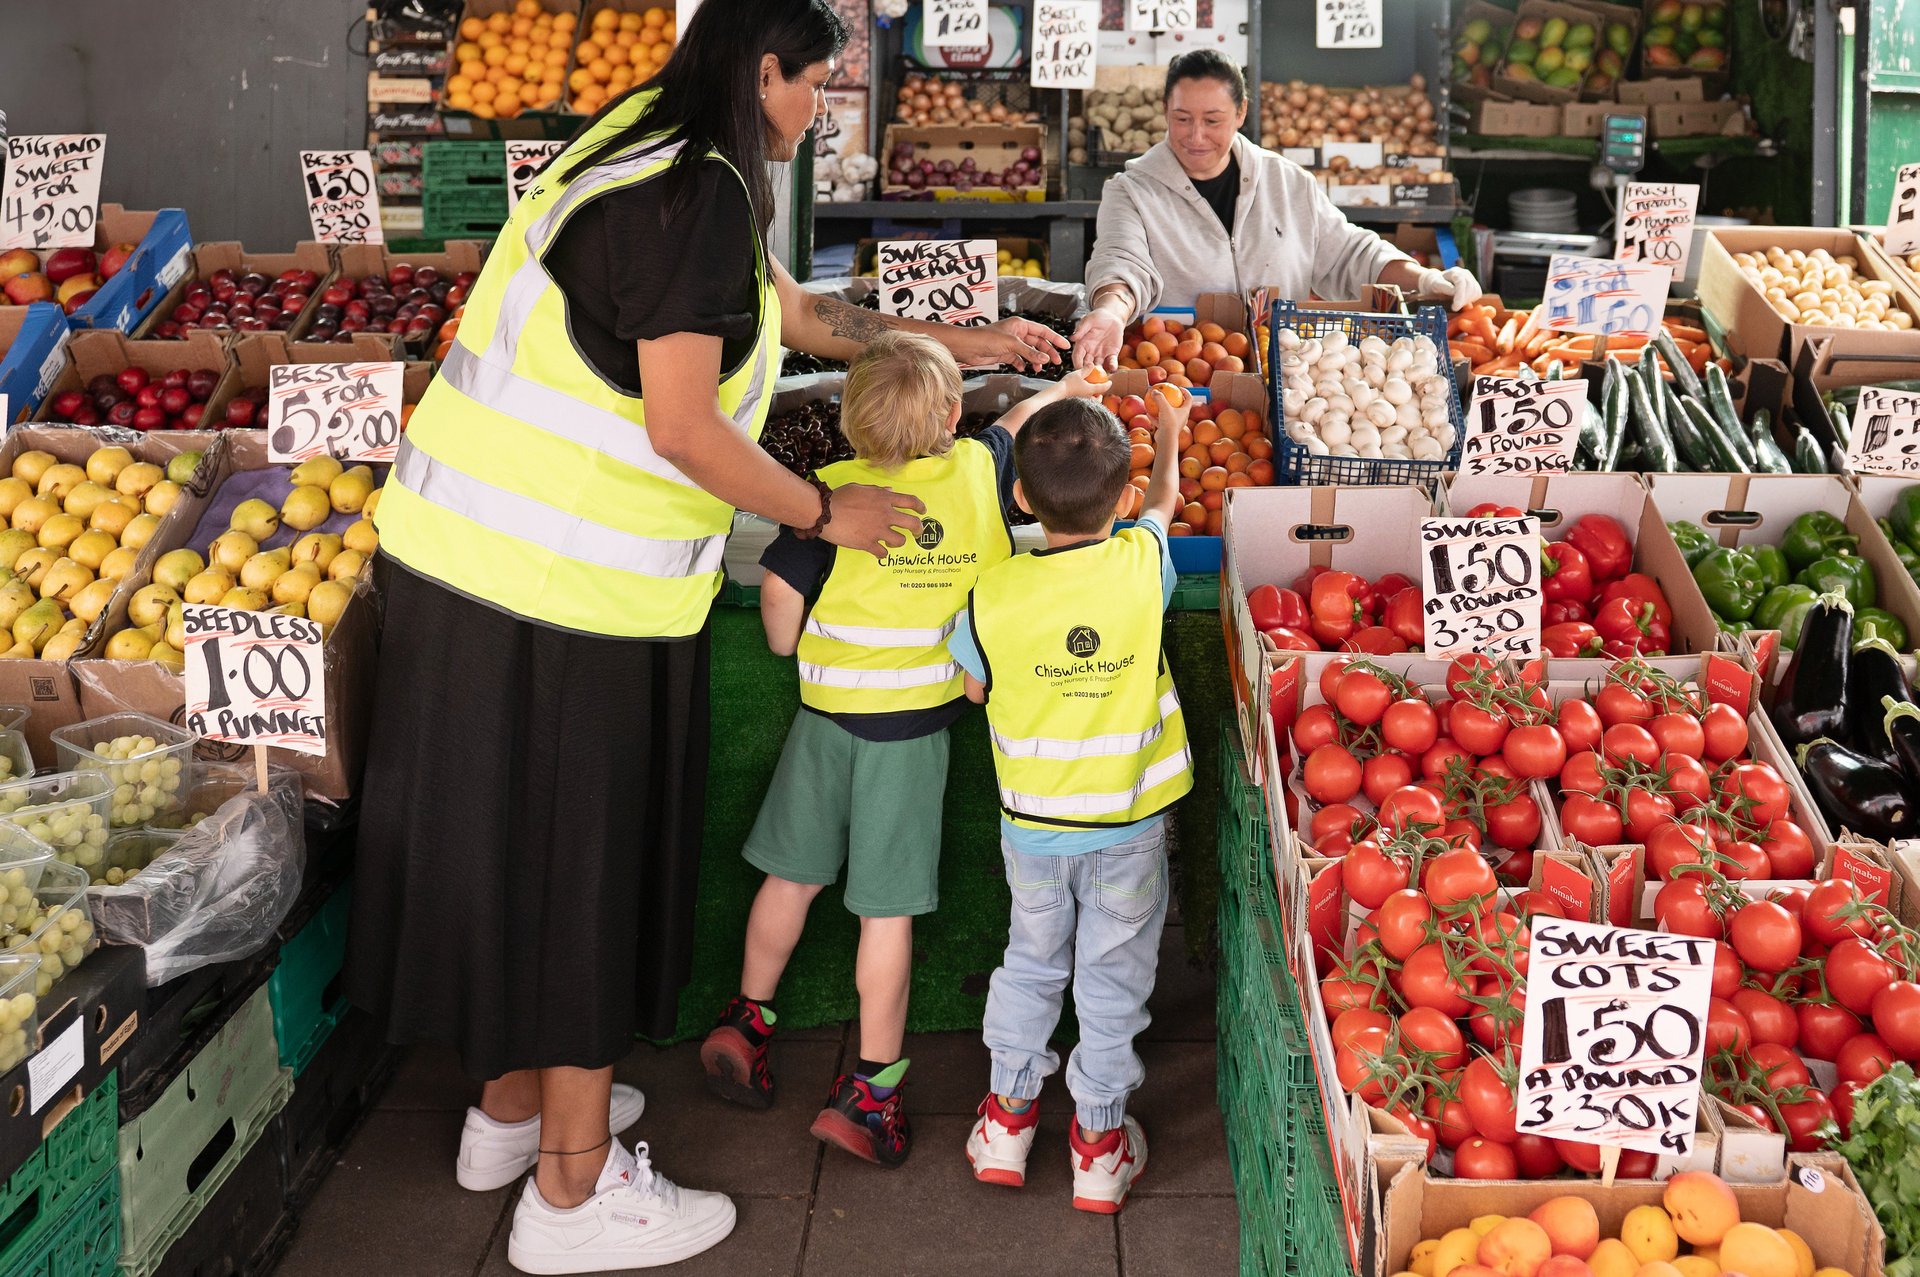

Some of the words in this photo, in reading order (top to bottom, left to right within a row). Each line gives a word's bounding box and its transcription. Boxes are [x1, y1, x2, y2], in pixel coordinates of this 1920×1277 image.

[1038, 65, 1048, 79] A
[1054, 60, 1088, 79] PACK
[303, 153, 355, 168] BEST
[508, 143, 562, 161] SWE
[15, 156, 93, 187] SWEET
[32, 175, 78, 199] FOR
[306, 168, 370, 200] 1.50
[1628, 186, 1676, 197] FRESH
[6, 196, 29, 233] 4
[310, 203, 319, 214] A
[322, 200, 365, 214] POUND
[315, 213, 370, 235] 3.30
[1644, 215, 1691, 230] POUNDS
[1646, 225, 1672, 239] FOR
[334, 230, 367, 244] KG
[880, 240, 973, 264] SWEET
[882, 254, 987, 285] CHERRY
[271, 362, 355, 389] BEST
[1476, 377, 1549, 398] BEST
[321, 374, 382, 405] FOR
[271, 389, 321, 455] 5
[1480, 397, 1573, 435] 1.50
[1466, 436, 1483, 454] A
[1489, 432, 1564, 455] POUND
[1421, 516, 1535, 541] SWEET
[904, 567, 926, 575] Nursery
[937, 552, 978, 566] House
[1429, 541, 1532, 595] 1.50
[1424, 597, 1445, 616] A
[1449, 587, 1538, 614] POUND
[183, 608, 321, 644] SEEDLESS
[1431, 608, 1525, 648] 3.30
[1472, 635, 1535, 655] KG
[202, 637, 311, 712] 1.00
[1034, 660, 1095, 678] Chiswick
[1097, 654, 1135, 673] House
[1064, 675, 1088, 684] Nursery
[1711, 678, 1741, 697] tomabel
[187, 711, 208, 737] A
[217, 708, 326, 739] PUNNET
[1843, 859, 1881, 884] tomabel
[1549, 884, 1583, 908] tomabel
[1535, 925, 1713, 966] SWEET
[1551, 961, 1681, 992] COTS
[1541, 996, 1700, 1067] 1.50
[1525, 1068, 1553, 1091] A
[1561, 1064, 1698, 1092] POUND
[1803, 1170, 1820, 1189] 116
